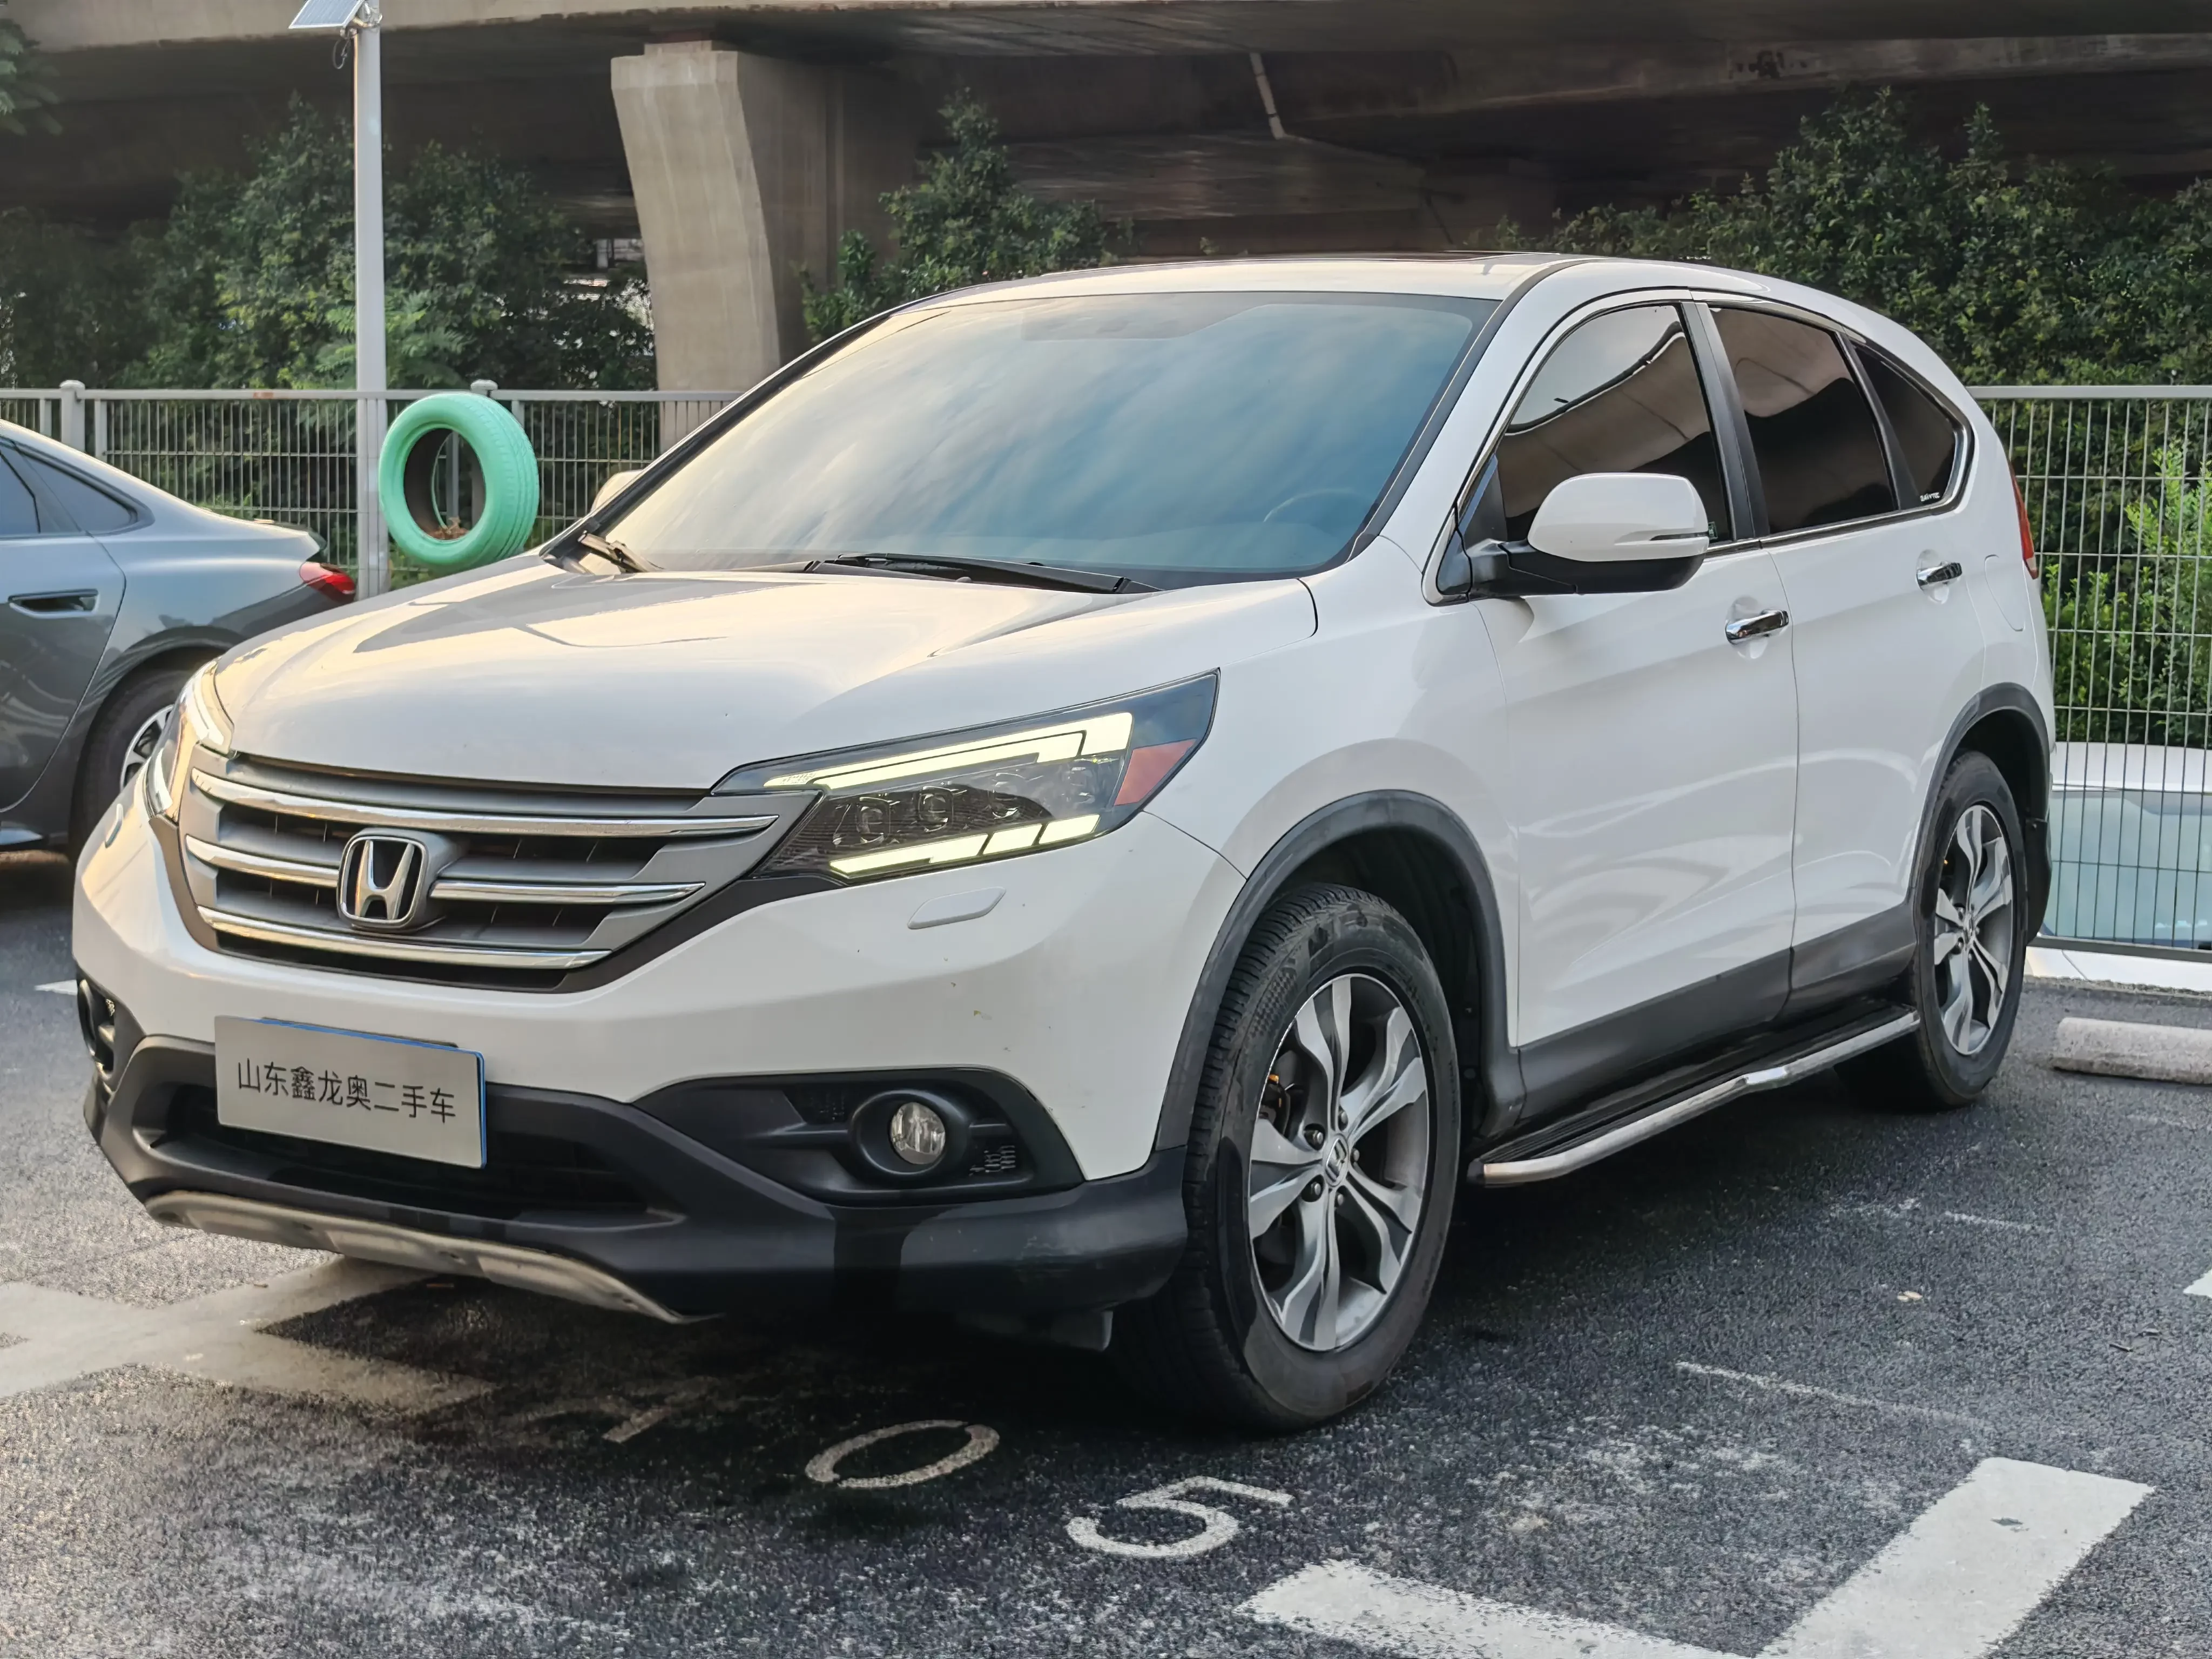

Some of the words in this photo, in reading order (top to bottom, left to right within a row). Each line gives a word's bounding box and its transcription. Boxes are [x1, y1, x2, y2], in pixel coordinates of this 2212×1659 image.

[238, 1057, 456, 1123] 山东鑫龙奥二手车
